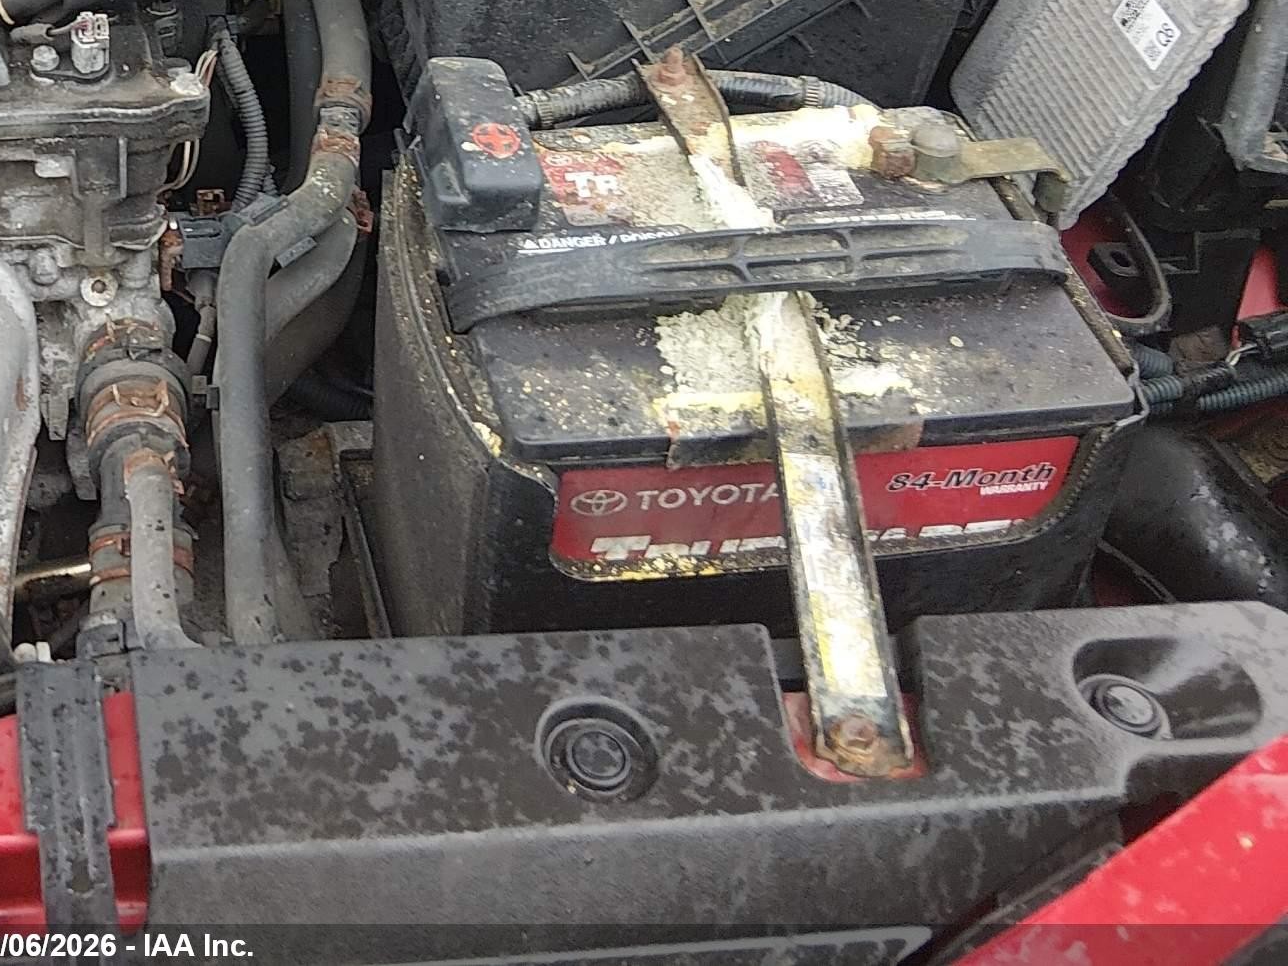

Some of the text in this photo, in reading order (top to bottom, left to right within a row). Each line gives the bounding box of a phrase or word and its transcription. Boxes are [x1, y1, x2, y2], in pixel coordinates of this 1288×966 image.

[539, 235, 607, 249] DANGER
[886, 461, 1058, 493] 84-Month
[636, 482, 780, 510] TOYOTA
[979, 481, 1049, 496] WARRANTY
